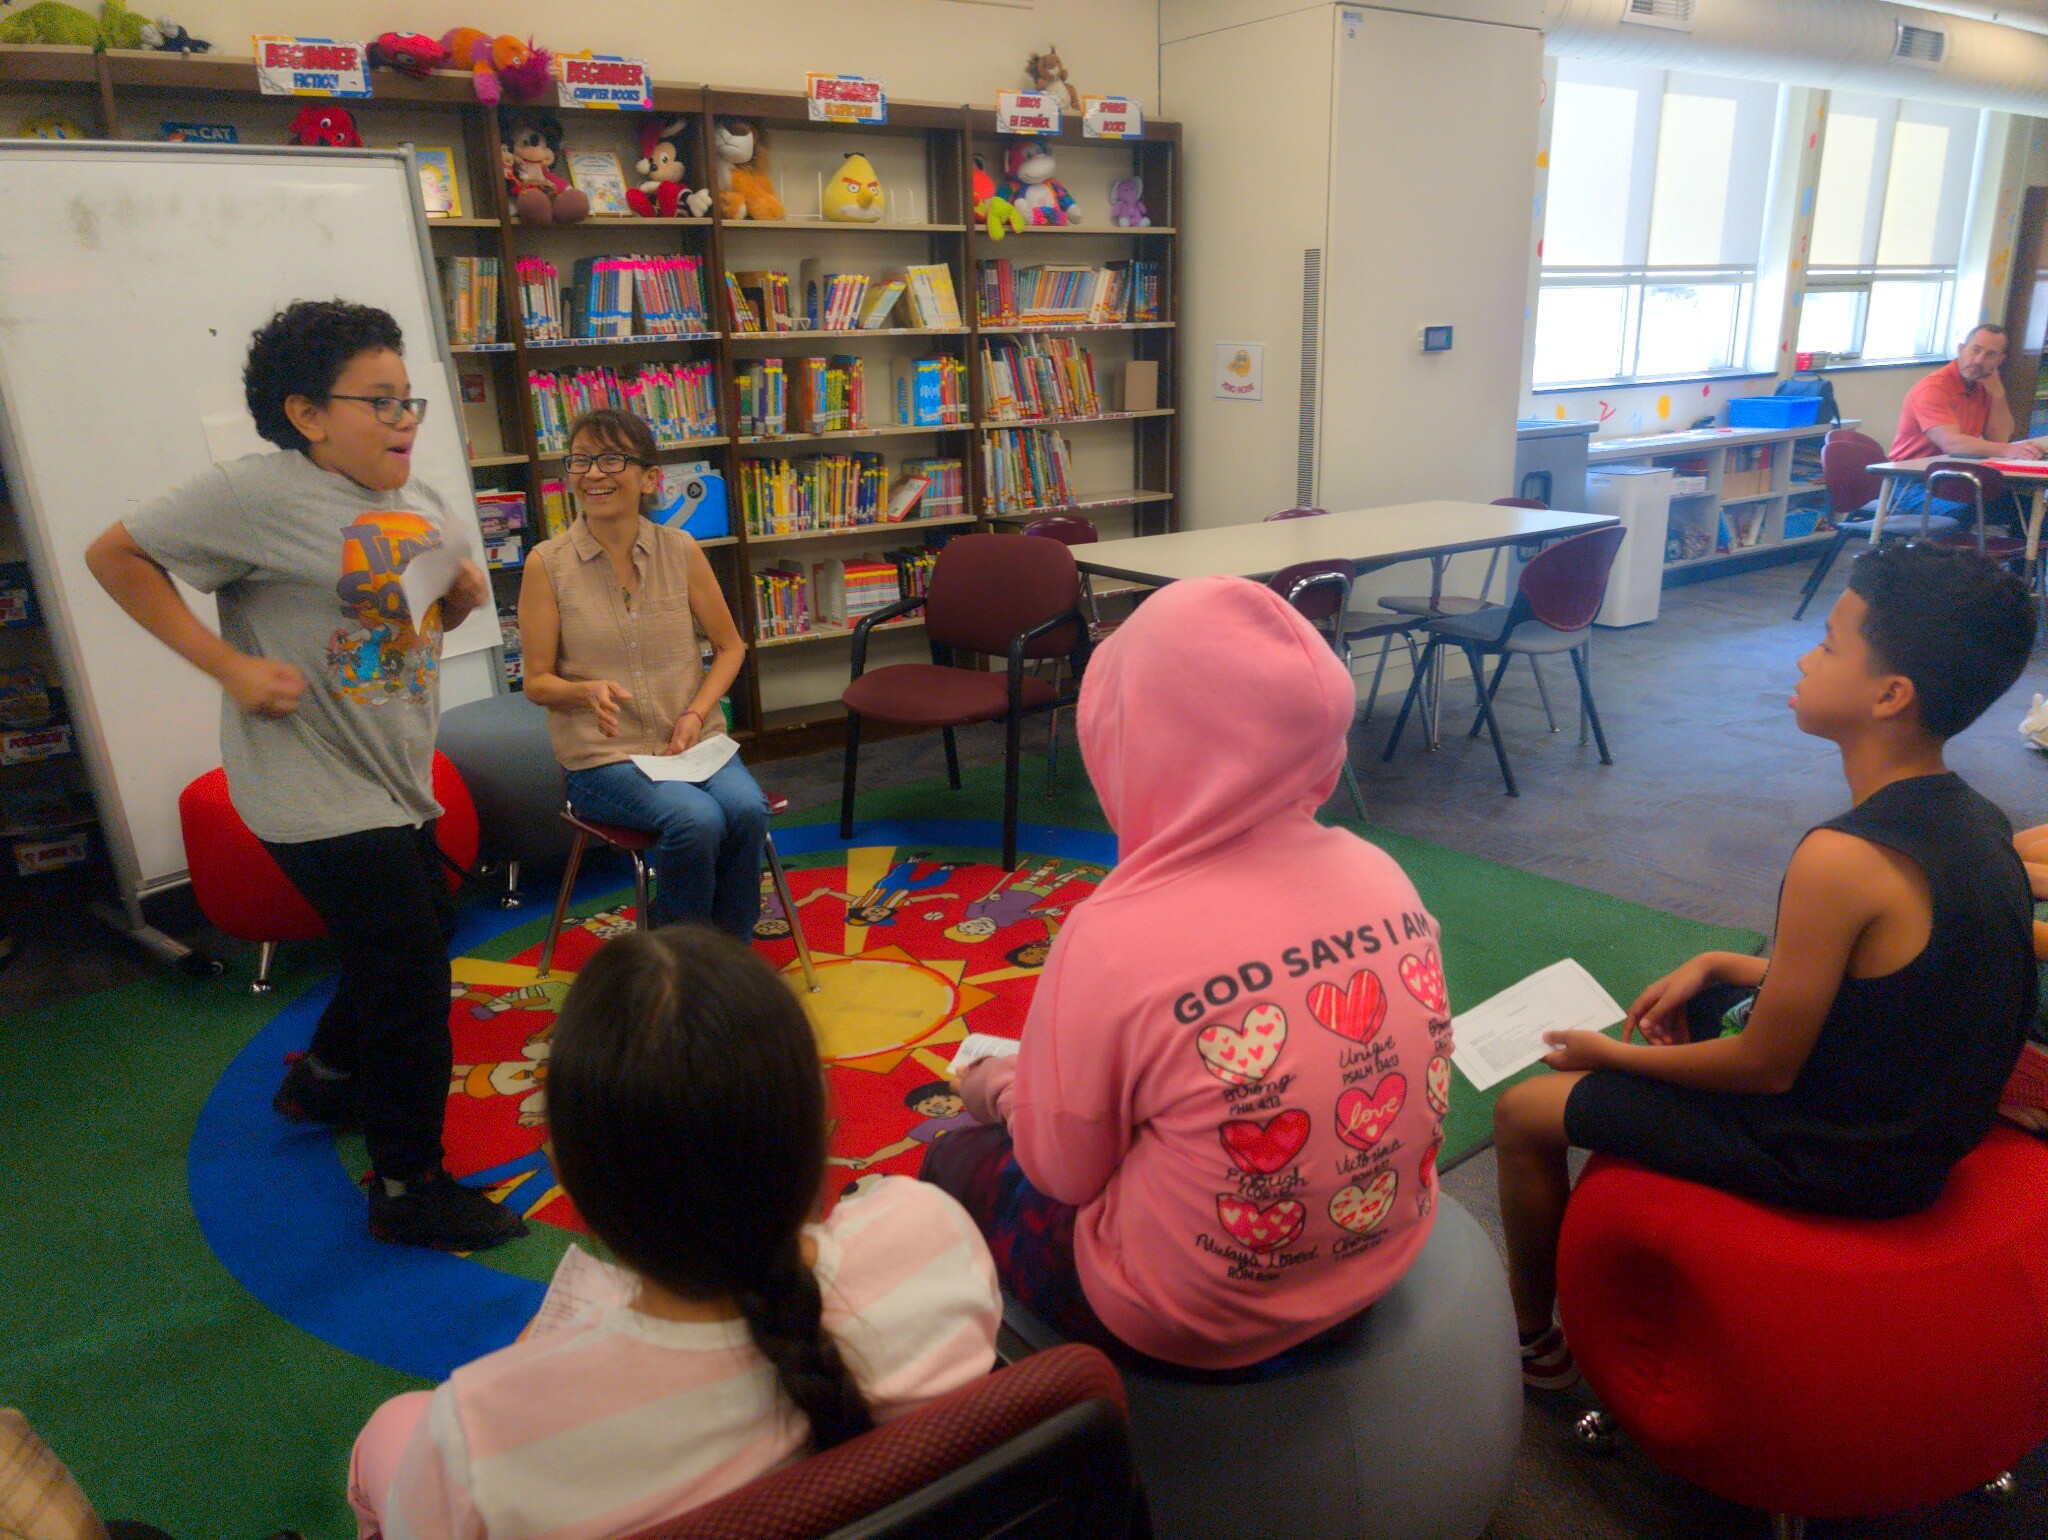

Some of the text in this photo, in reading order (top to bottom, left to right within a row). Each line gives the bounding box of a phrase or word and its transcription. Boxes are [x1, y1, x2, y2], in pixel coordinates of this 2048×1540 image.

[265, 43, 359, 71] BEGINNER
[293, 72, 339, 89] FICTION
[566, 61, 643, 86] BEGINNER
[611, 88, 639, 101] BOOKS
[1016, 96, 1042, 109] LIBROS
[201, 128, 231, 139] CAT
[1102, 121, 1126, 132] BOOKS
[1173, 912, 1432, 1025] GOD SAYS I AM
[1340, 1035, 1396, 1069] Unique
[1342, 1097, 1400, 1137] love
